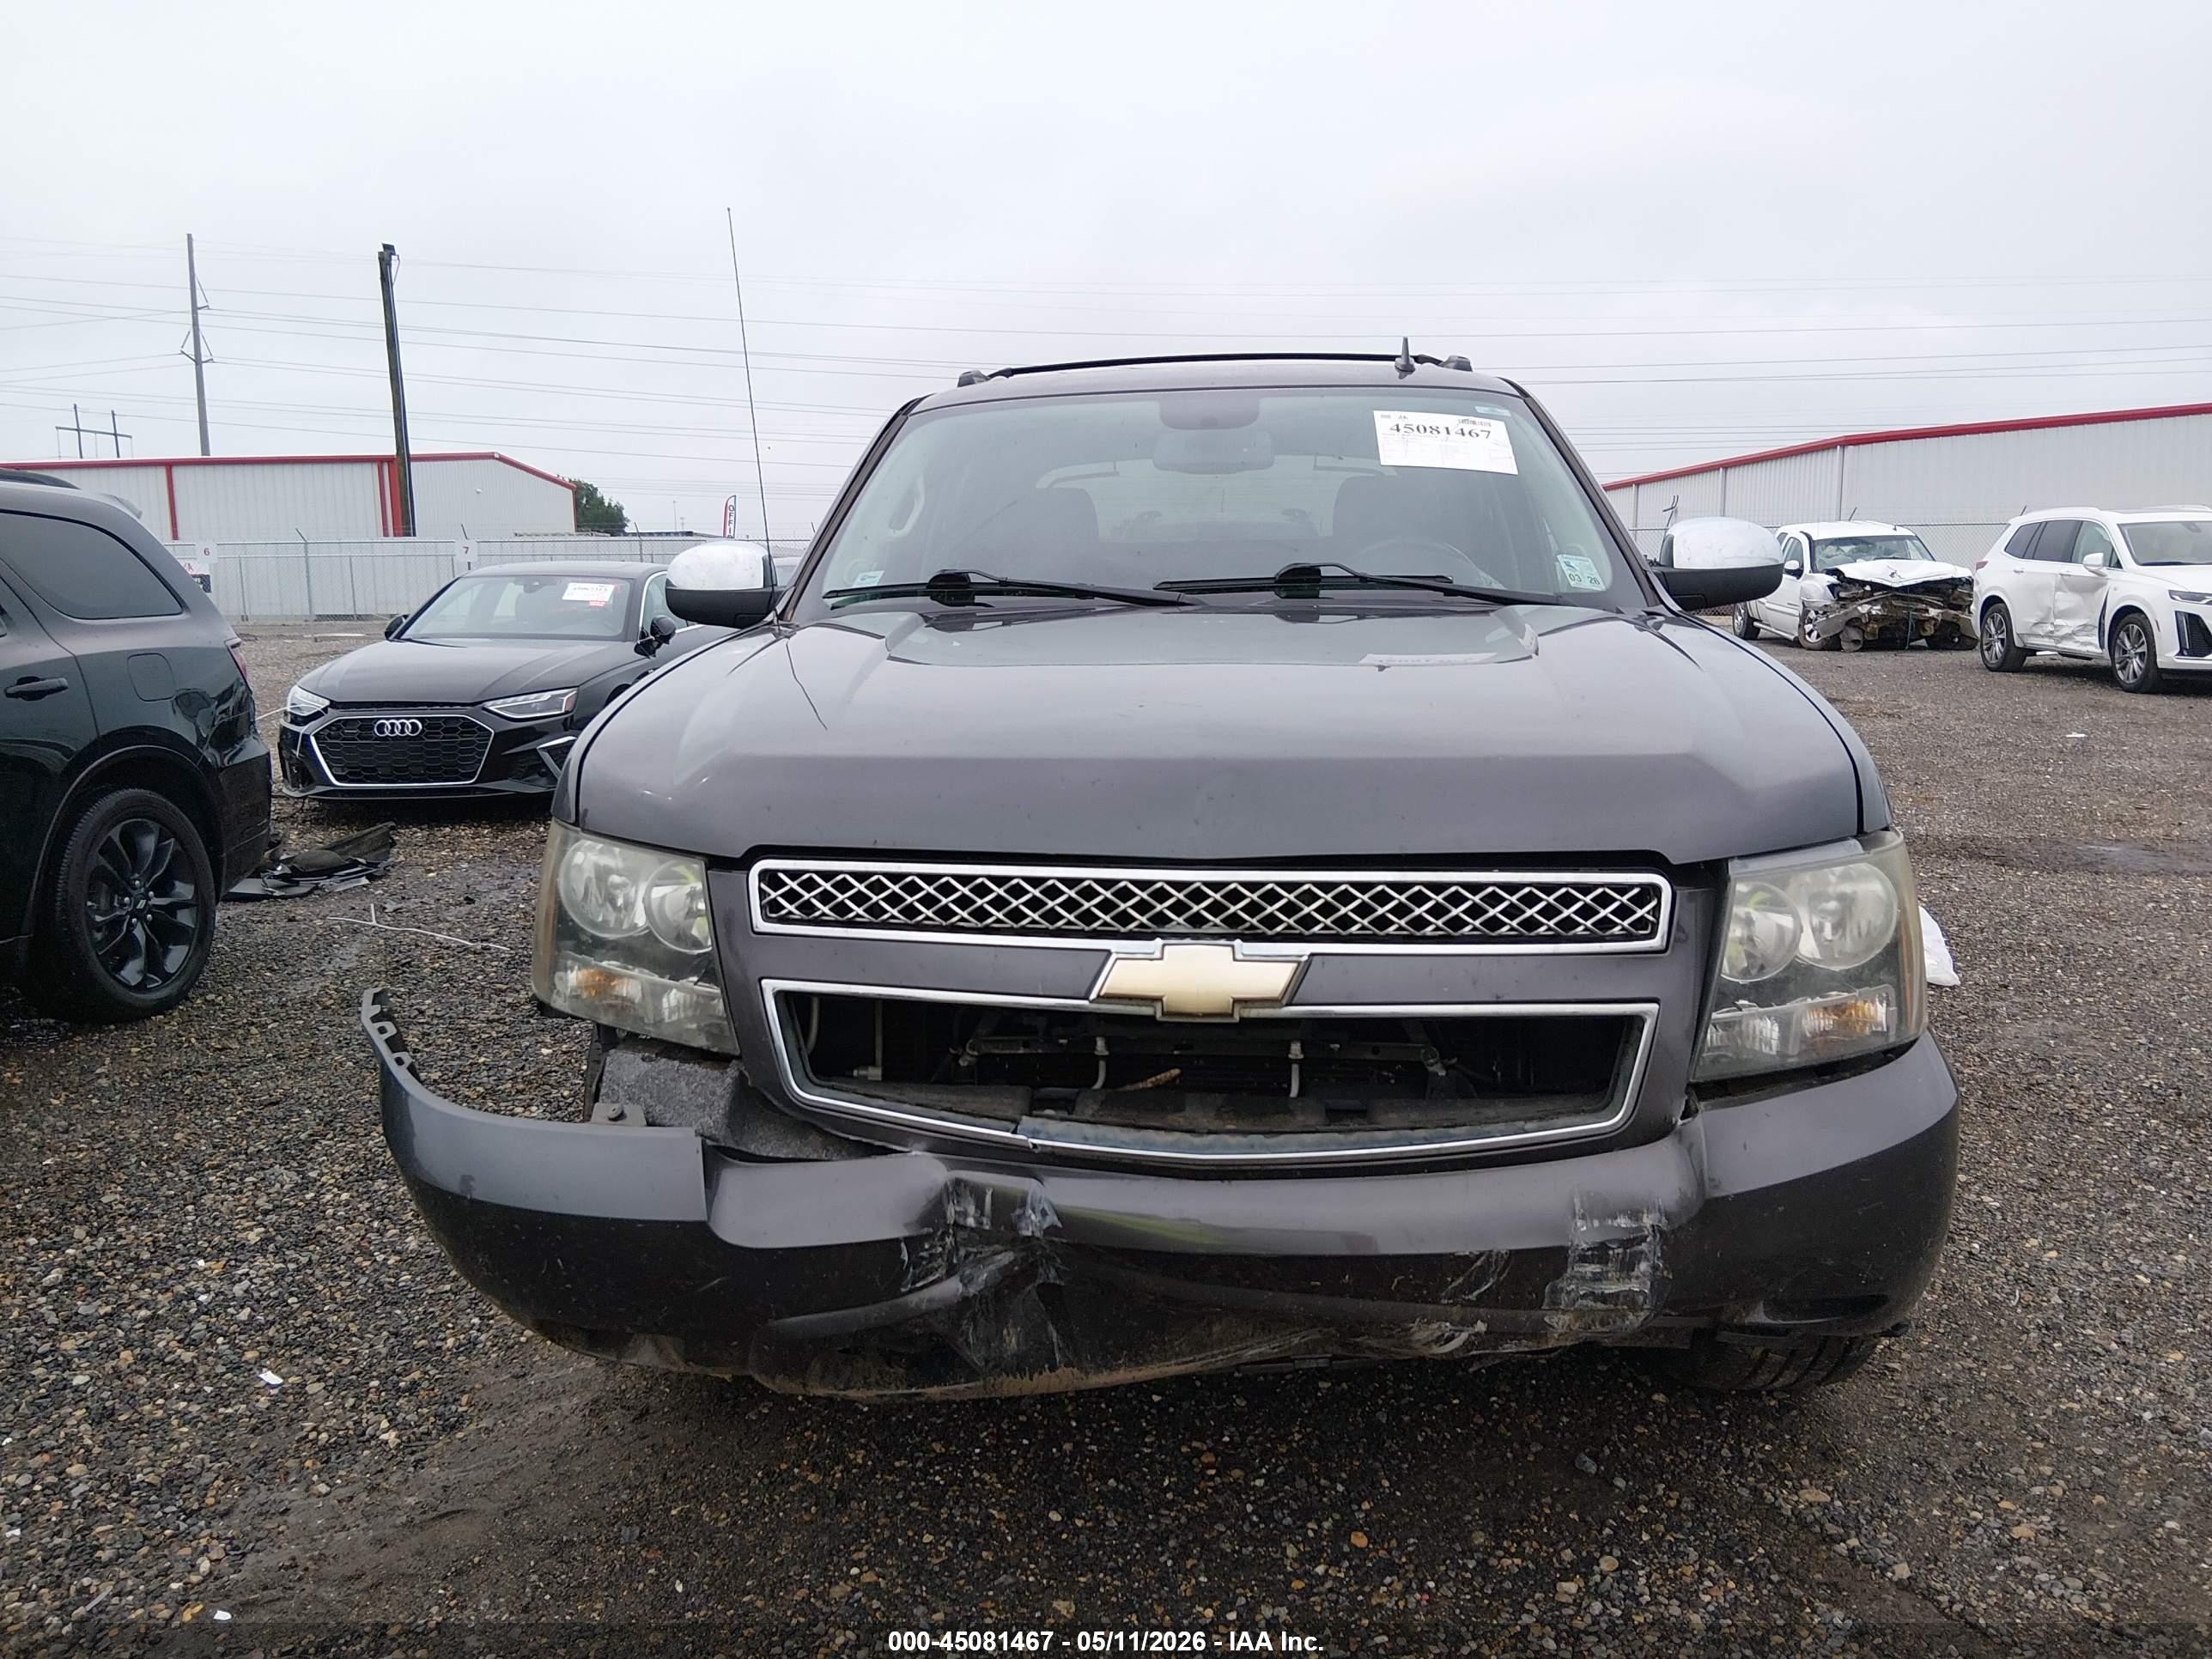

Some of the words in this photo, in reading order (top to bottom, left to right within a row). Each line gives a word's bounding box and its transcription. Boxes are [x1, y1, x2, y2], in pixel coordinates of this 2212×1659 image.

[1389, 422, 1492, 440] 45081467
[204, 548, 210, 556] 6
[1568, 573, 1582, 582] 03
